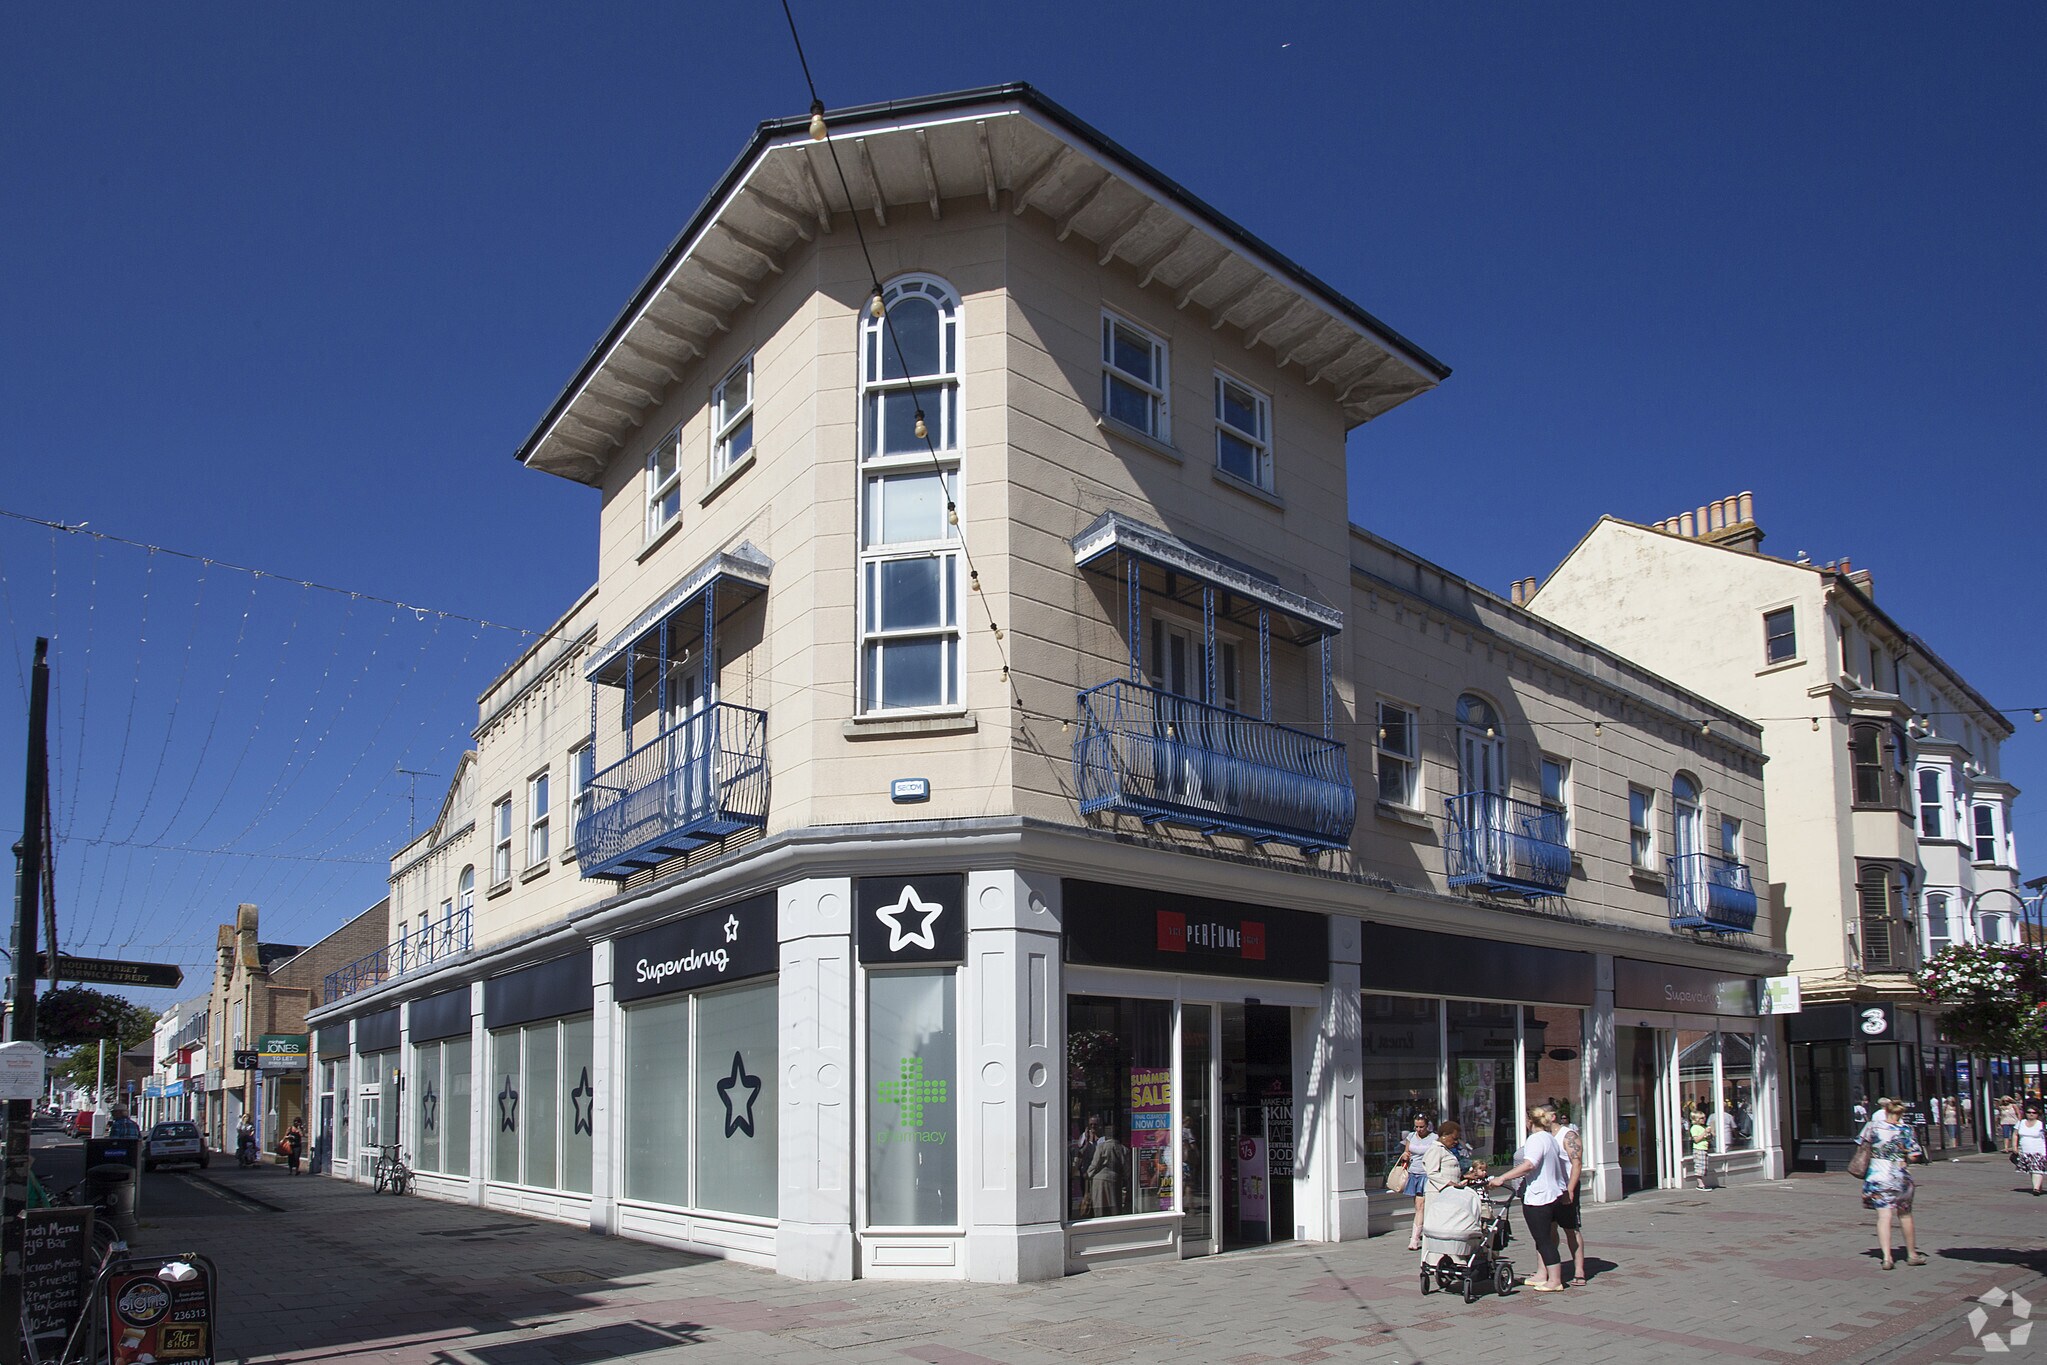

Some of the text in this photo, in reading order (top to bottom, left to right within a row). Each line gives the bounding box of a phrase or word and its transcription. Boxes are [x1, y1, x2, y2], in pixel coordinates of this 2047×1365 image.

[1187, 923, 1241, 949] PERFUME
[61, 961, 139, 974] SOUTH STREET
[636, 948, 730, 984] Superdrug
[60, 969, 150, 982] WARWICK STREET
[1664, 984, 1722, 1009] Superdrug
[1861, 1008, 1888, 1035] 3
[266, 1044, 299, 1053] JONES
[1131, 1072, 1170, 1086] SUMMER
[1131, 1084, 1171, 1108] SALE
[1261, 1098, 1293, 1107] MAKE-UP
[1261, 1107, 1293, 1120] SKIN
[1135, 1120, 1166, 1129] NOW ON
[1240, 1145, 1253, 1159] 1/3
[1268, 1149, 1293, 1160] OOD
[1269, 1167, 1293, 1176] EALTH
[25, 1222, 80, 1237] nch Menu
[47, 1239, 71, 1249] Bar
[26, 1263, 53, 1273] icious
[119, 1291, 169, 1313] signs
[174, 1308, 206, 1321] 236313
[172, 1330, 197, 1343] Art
[167, 1340, 196, 1349] SHOP
